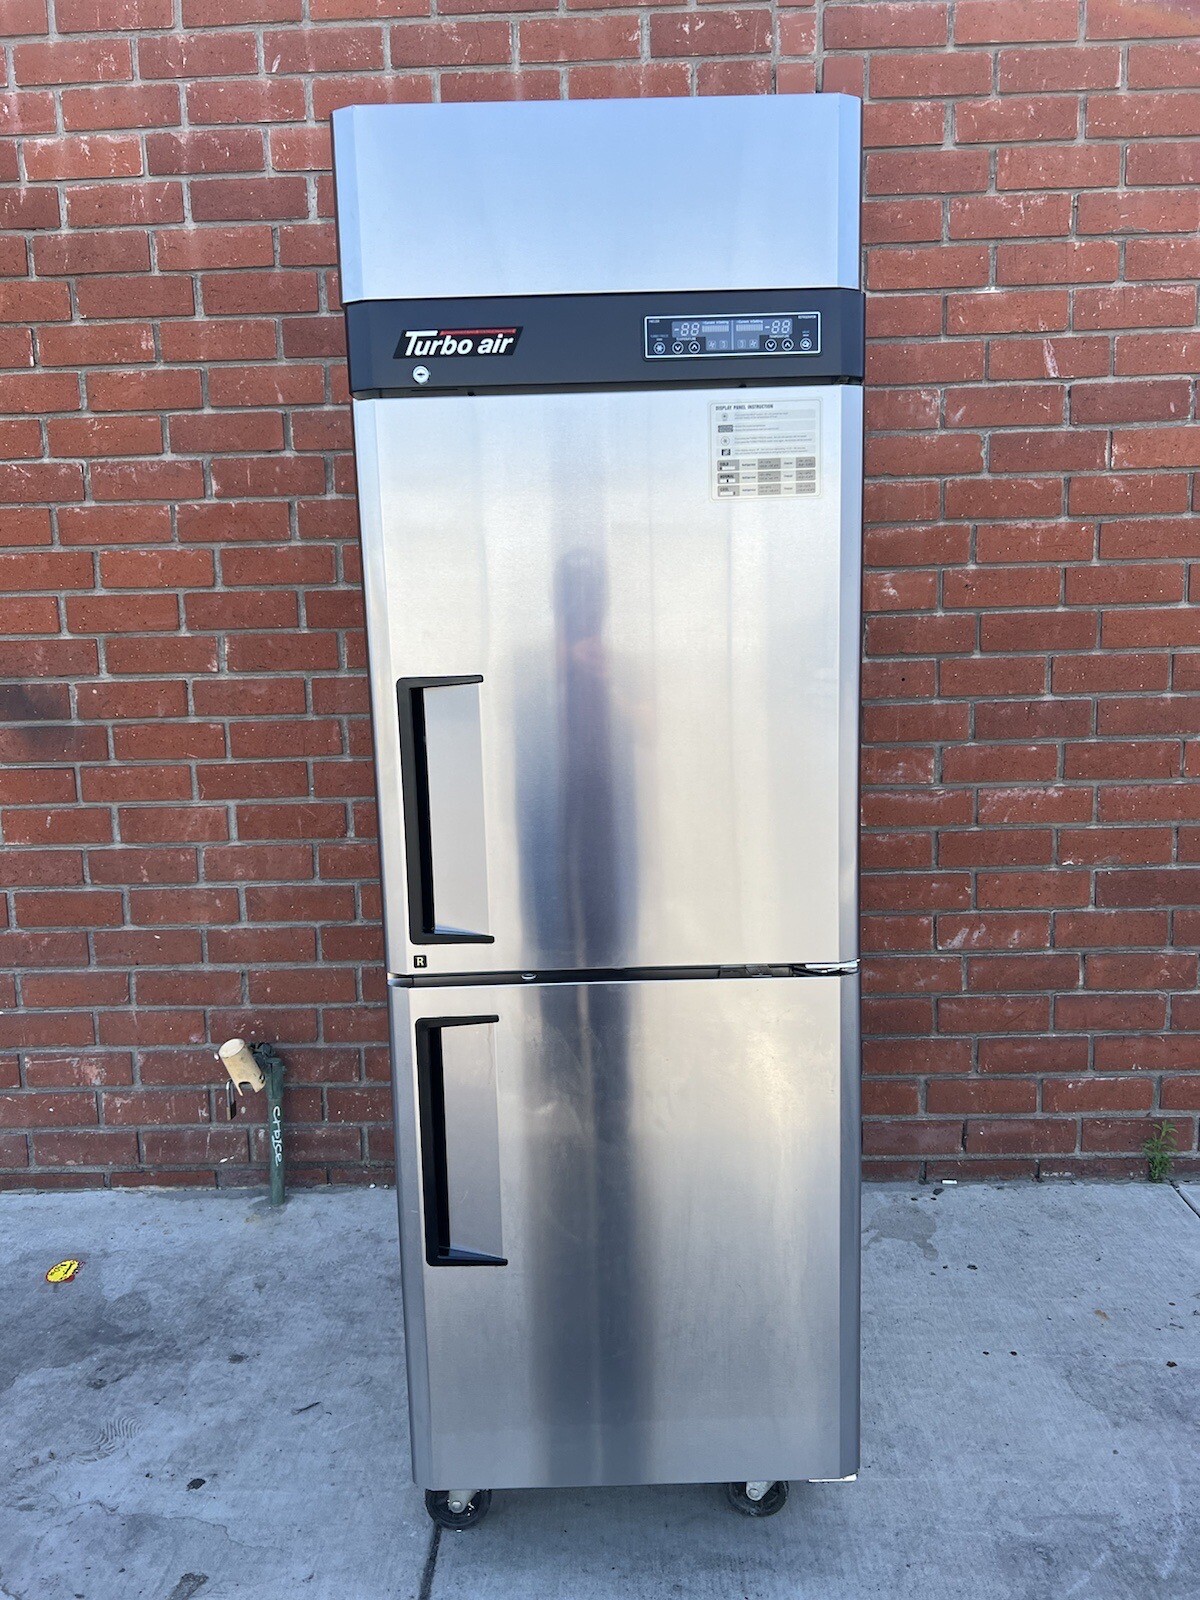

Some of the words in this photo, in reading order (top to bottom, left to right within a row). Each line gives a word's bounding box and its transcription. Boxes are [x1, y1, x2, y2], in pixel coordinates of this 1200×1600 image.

[405, 330, 473, 356] Turbo
[477, 333, 514, 354] air
[416, 957, 425, 966] R
